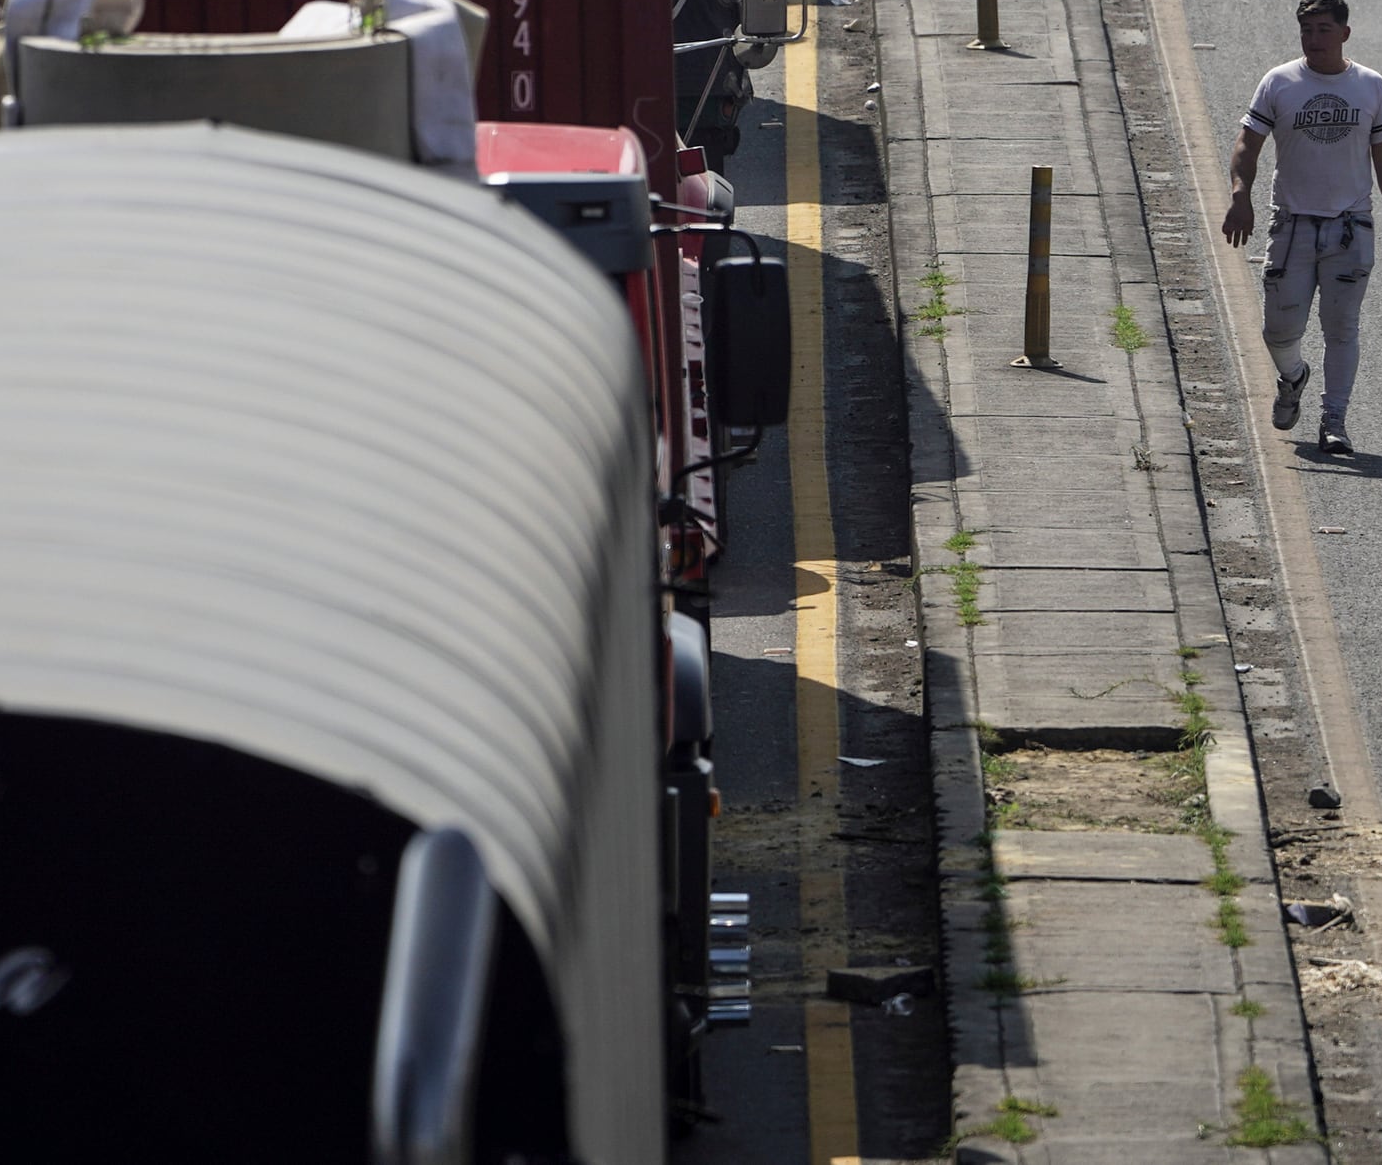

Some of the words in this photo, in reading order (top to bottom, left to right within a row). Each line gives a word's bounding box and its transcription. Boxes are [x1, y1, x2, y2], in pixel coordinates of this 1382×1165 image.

[512, 71, 534, 111] 0
[1293, 111, 1320, 126] JUST
[1333, 109, 1348, 122] DO
[1352, 108, 1361, 122] IT
